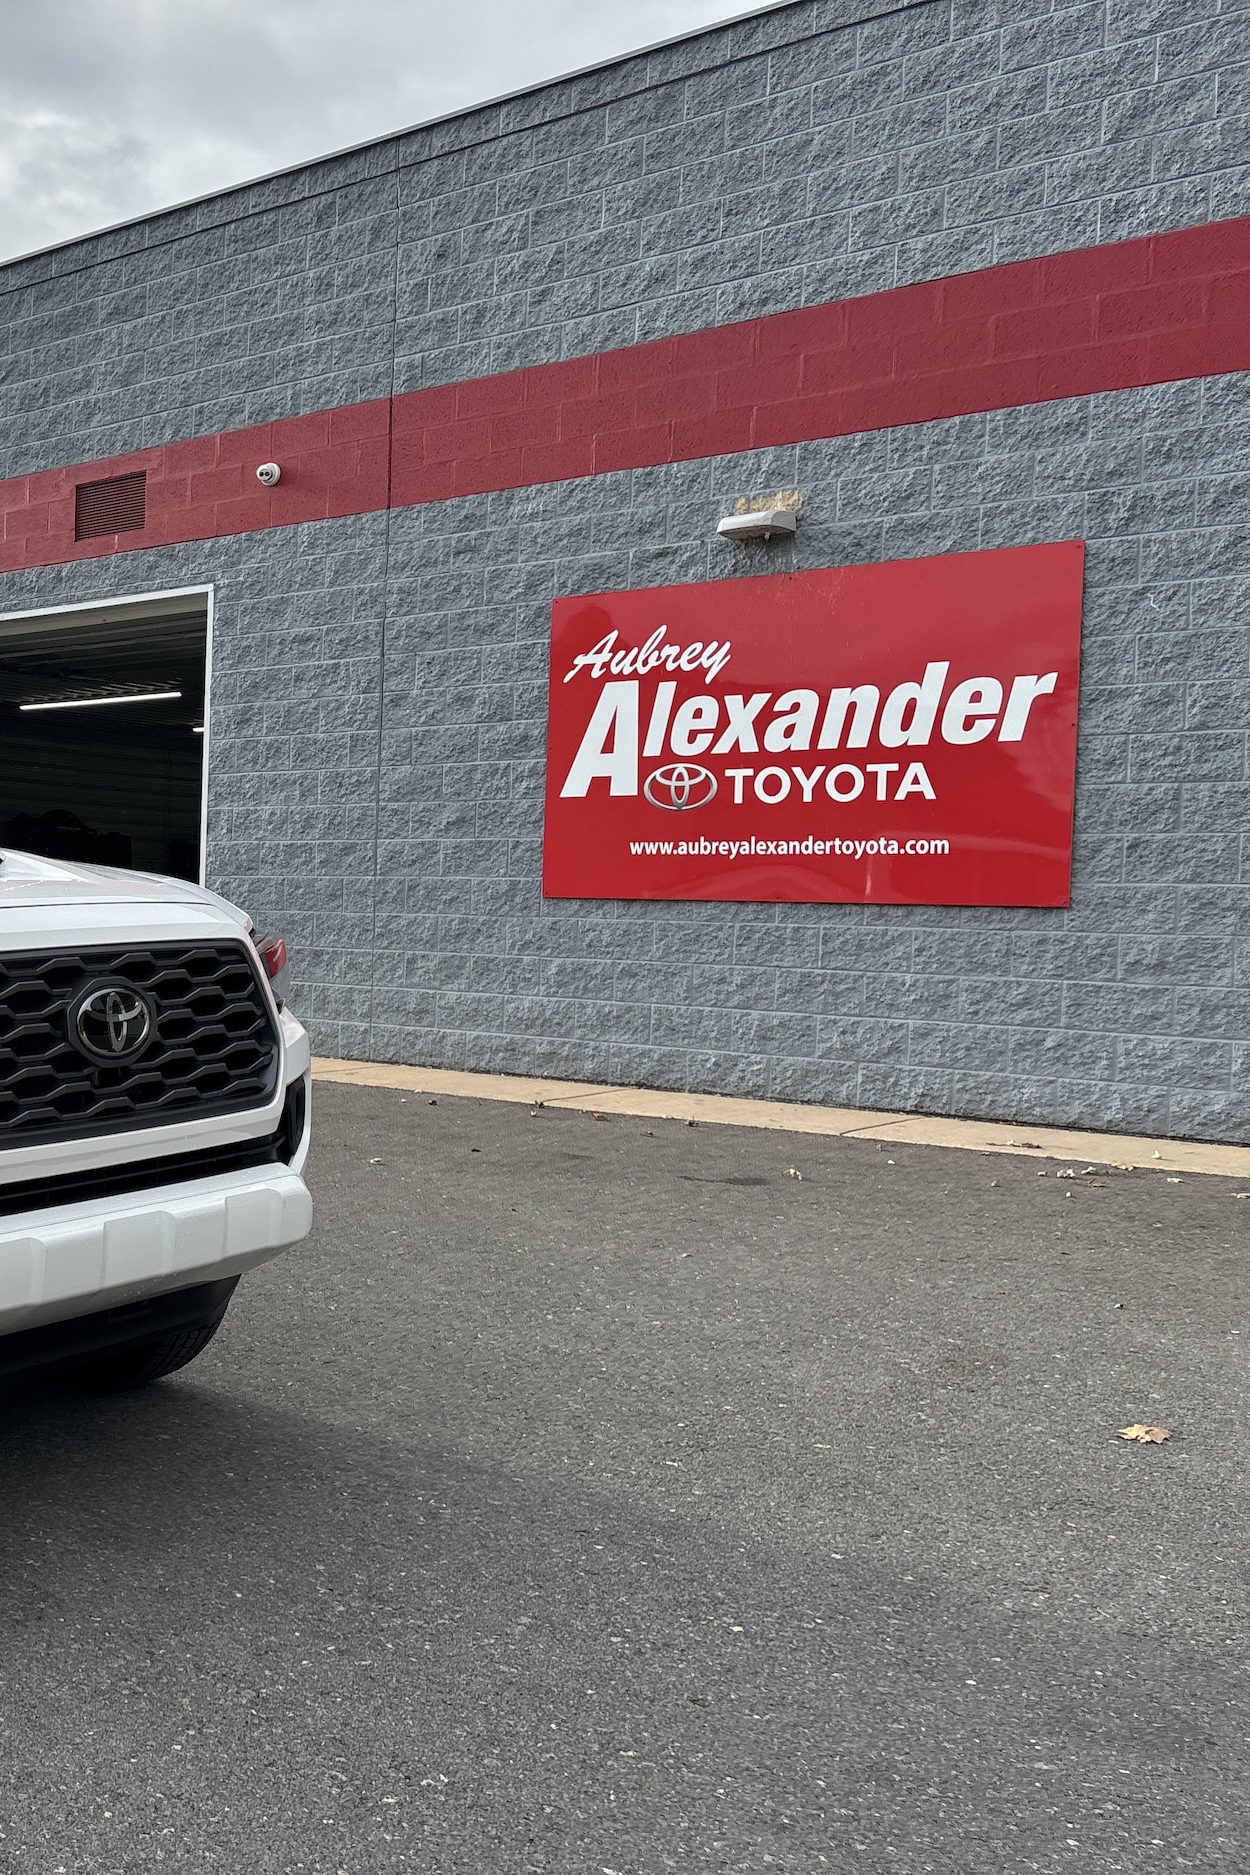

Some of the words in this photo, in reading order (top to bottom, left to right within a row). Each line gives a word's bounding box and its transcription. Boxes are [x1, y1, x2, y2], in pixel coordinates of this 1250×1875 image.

[563, 625, 731, 684] Aubrey
[560, 661, 1058, 798] Alexander
[725, 762, 936, 804] TOYOTA
[630, 836, 949, 859] www.aubreyalexandertoyota.com
